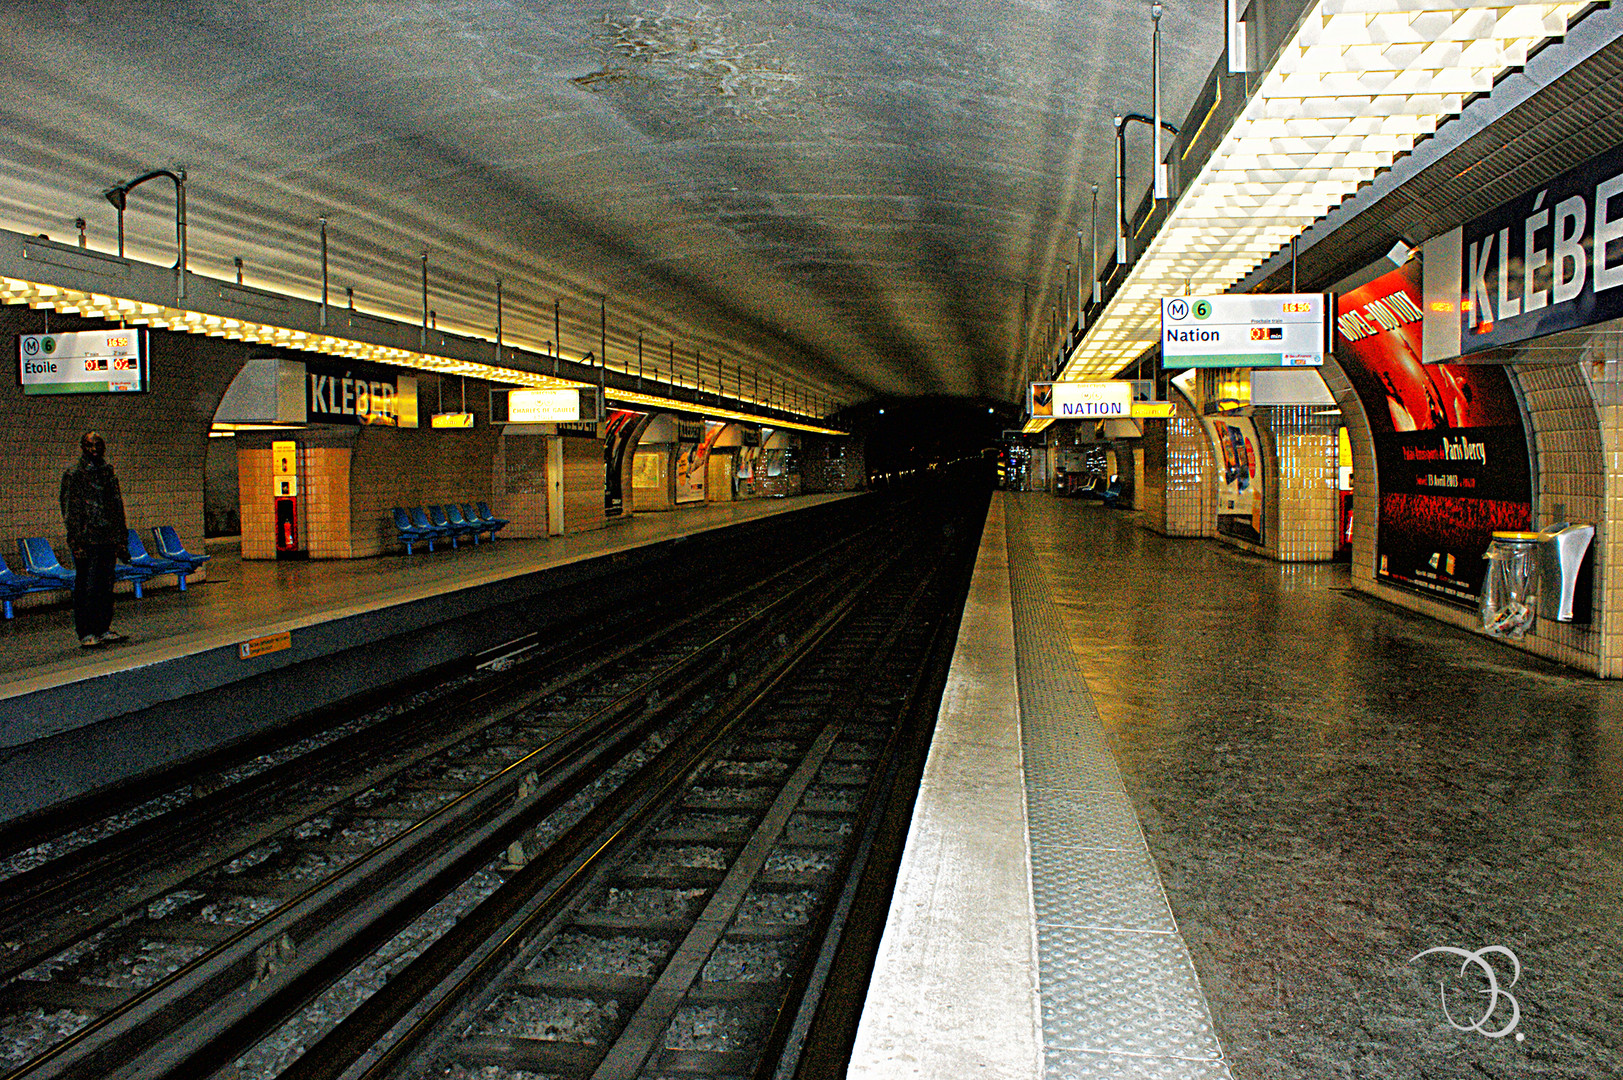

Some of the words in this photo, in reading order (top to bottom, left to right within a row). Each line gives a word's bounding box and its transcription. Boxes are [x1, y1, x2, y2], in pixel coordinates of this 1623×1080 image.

[1468, 173, 1623, 330] KLÉBE
[1197, 303, 1207, 316] 6
[1380, 289, 1424, 324] VOIX
[1363, 299, 1401, 332] 100
[1167, 328, 1220, 342] Nation
[1250, 327, 1270, 340] 01
[45, 340, 52, 351] 6
[25, 360, 58, 374] Étoile
[311, 371, 396, 417] KLÉBER
[1063, 402, 1122, 415] NATION
[1442, 436, 1463, 461] Paris
[1461, 435, 1487, 466] Bercy
